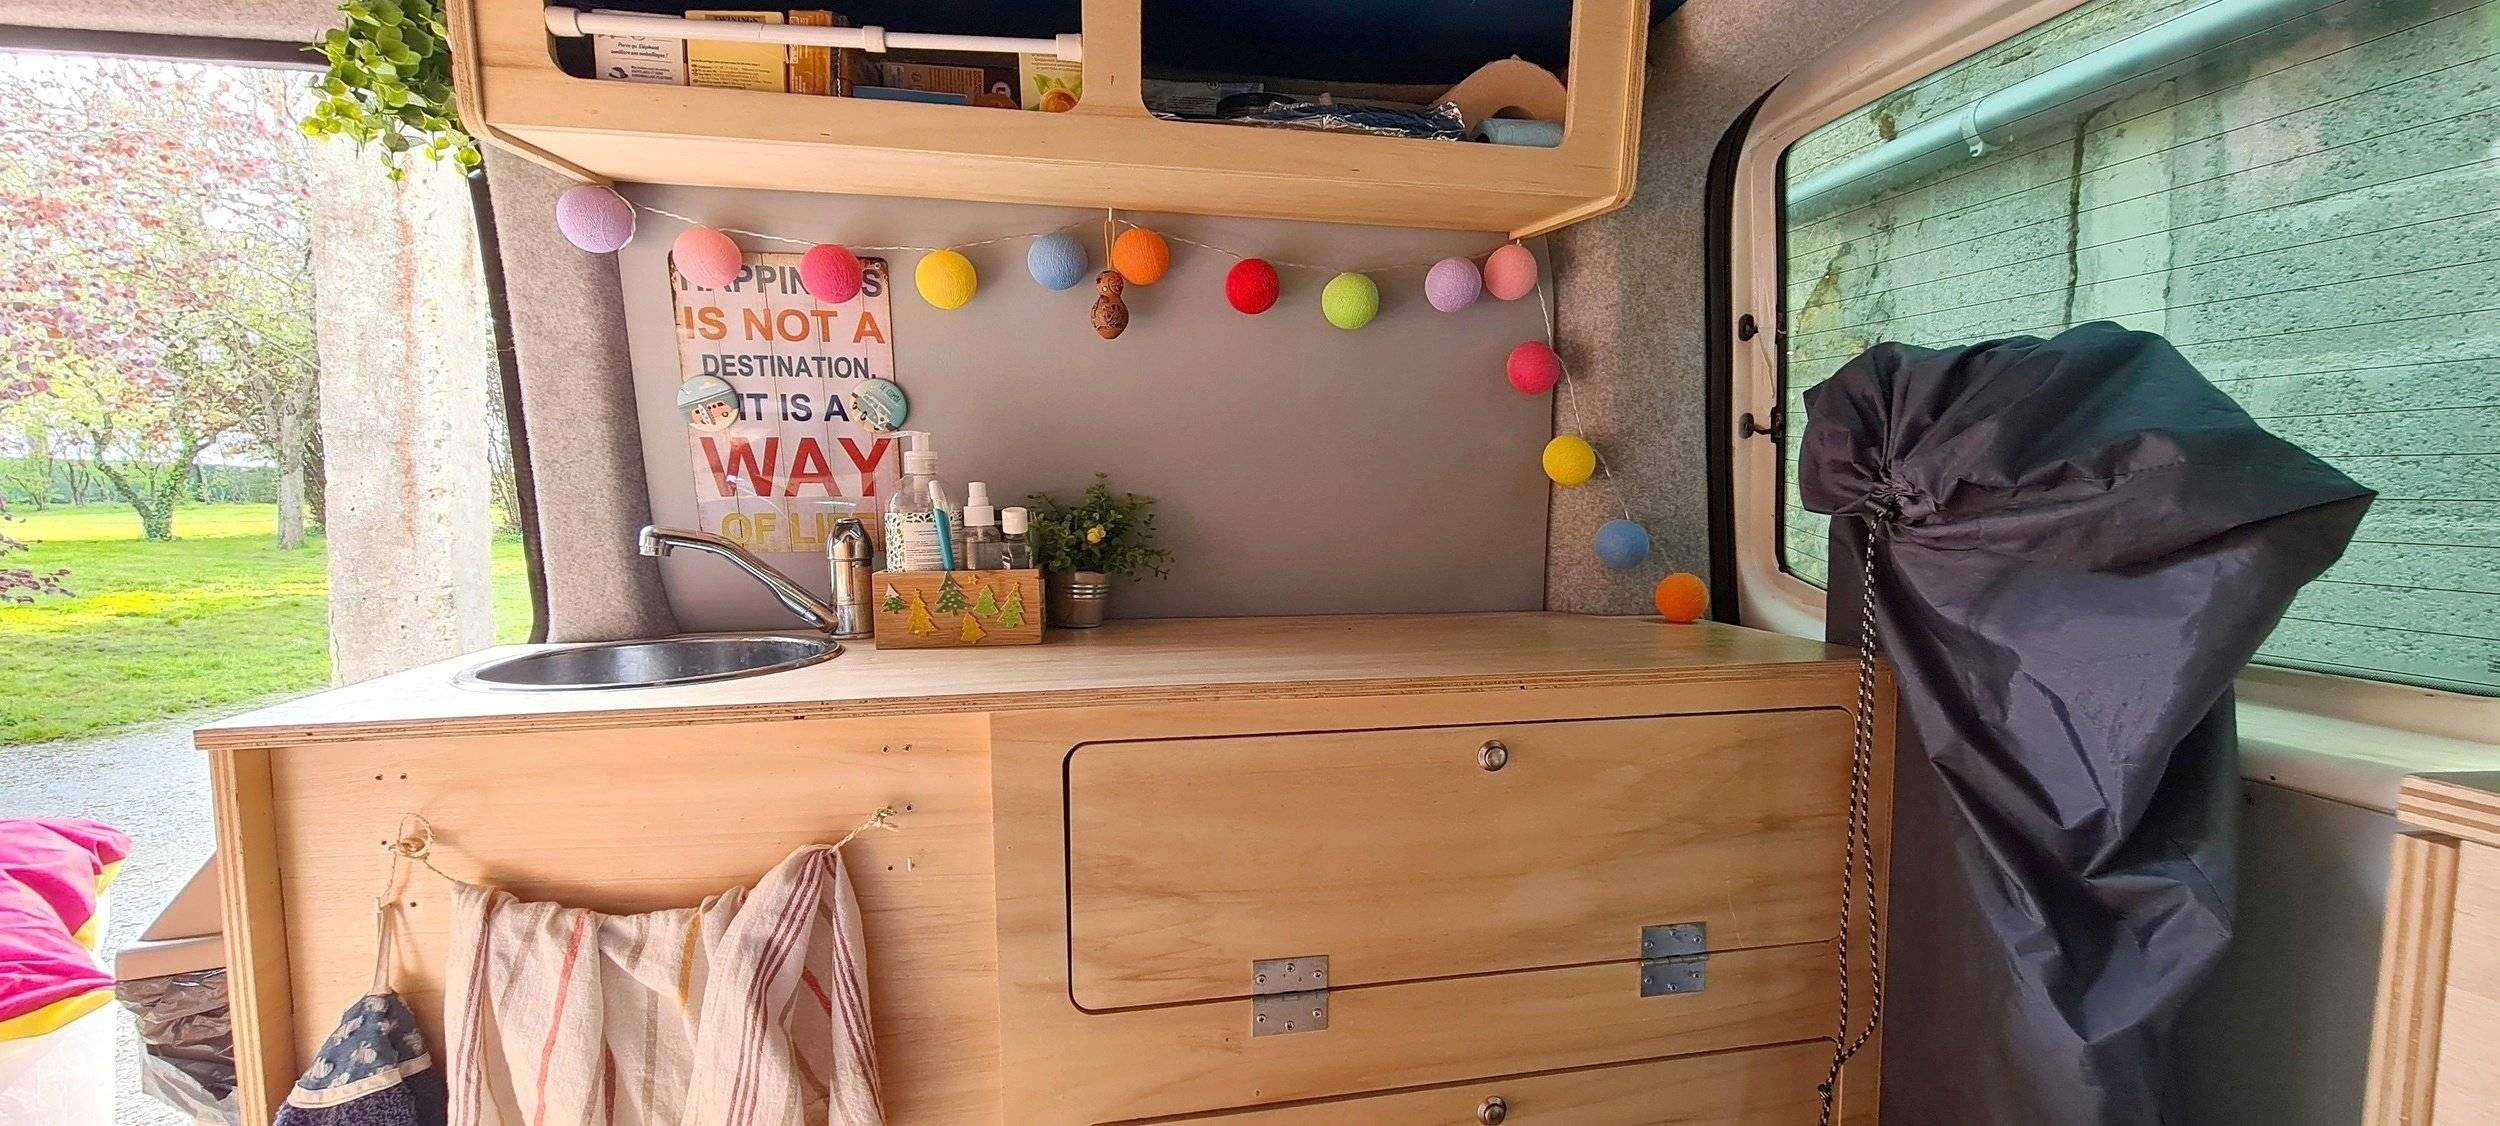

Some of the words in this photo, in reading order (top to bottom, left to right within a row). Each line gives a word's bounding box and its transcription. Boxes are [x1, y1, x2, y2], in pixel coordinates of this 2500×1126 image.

[681, 265, 882, 297] PPINS
[684, 306, 727, 341] IS
[743, 307, 838, 343] NOT
[853, 311, 886, 343] A
[702, 354, 877, 379] DESTINATION.
[738, 393, 768, 421] IT
[781, 393, 813, 421] IS
[824, 394, 850, 422] A
[700, 437, 891, 497] WAY
[721, 512, 776, 544] OF
